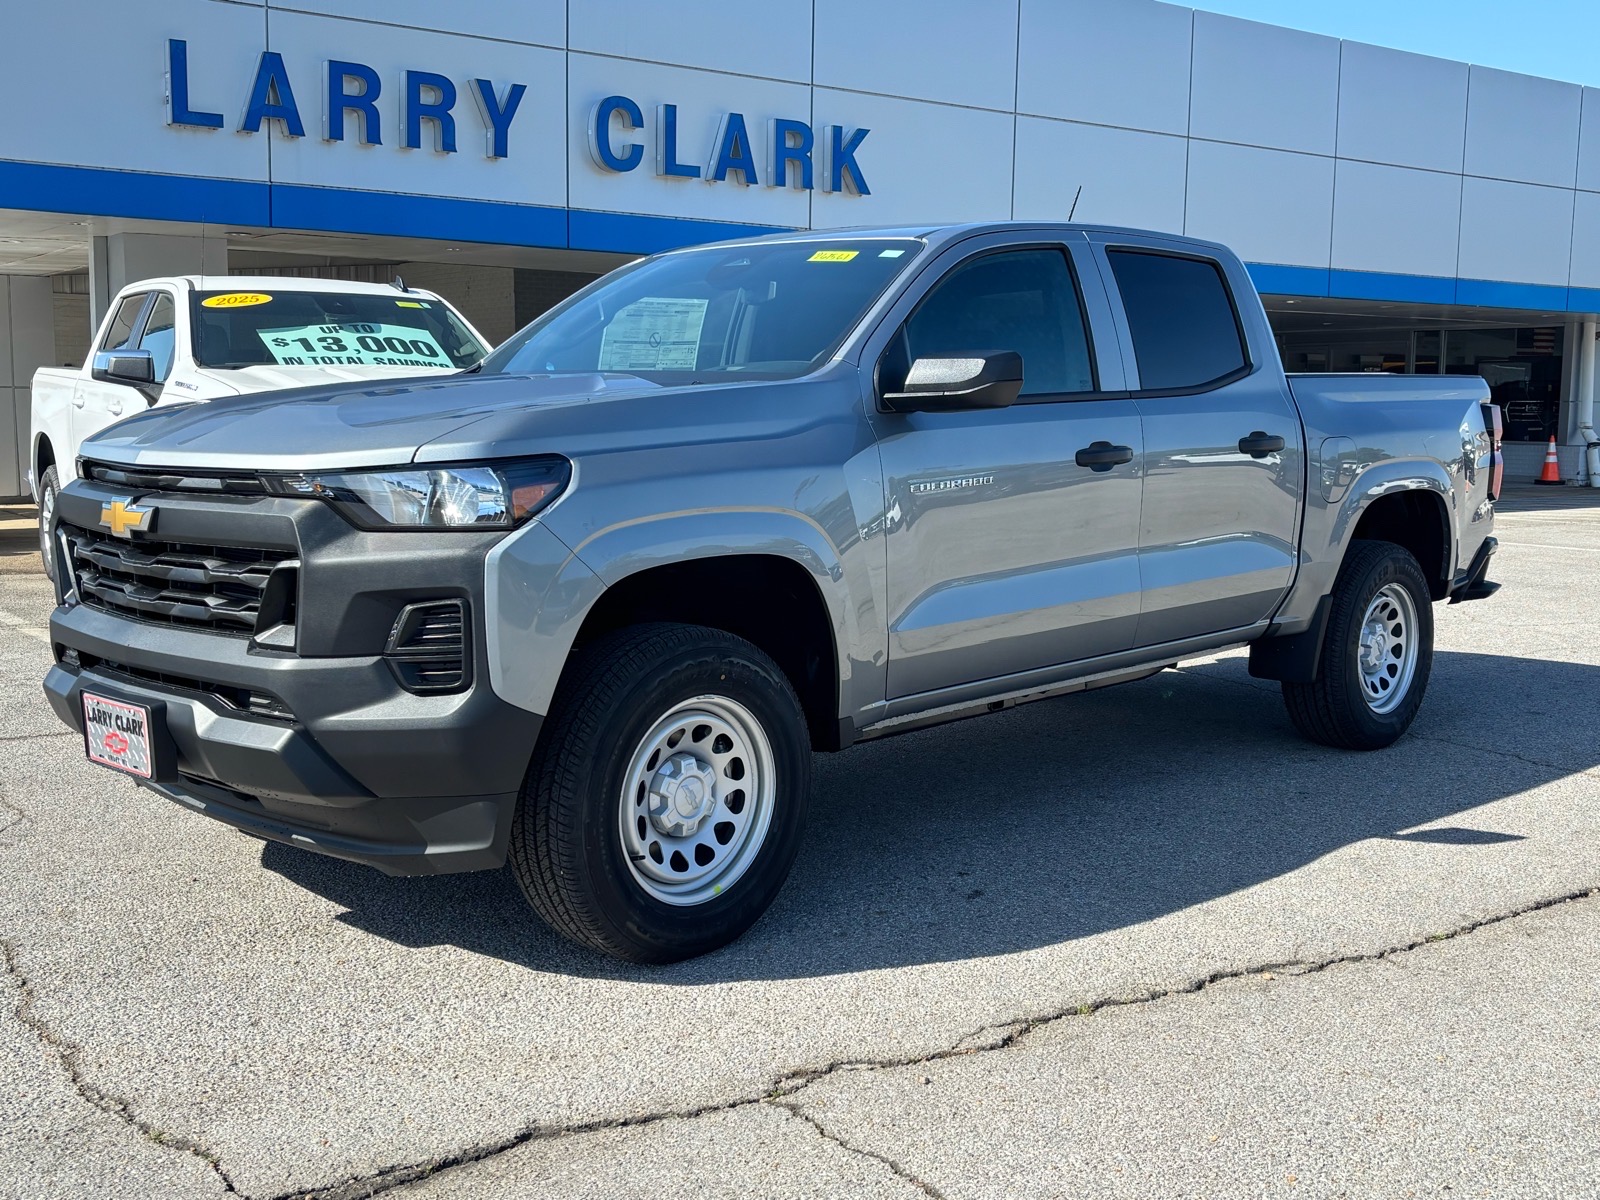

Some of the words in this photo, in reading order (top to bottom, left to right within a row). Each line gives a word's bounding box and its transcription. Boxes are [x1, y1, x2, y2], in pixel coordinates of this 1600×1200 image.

[166, 39, 527, 158] LARRY
[588, 96, 871, 195] CLARK
[215, 295, 260, 306] 2025
[319, 325, 344, 334] UP
[349, 324, 375, 334] TO
[271, 336, 439, 358] $13,000
[282, 356, 305, 365] IN
[910, 476, 994, 493] COLORADO
[87, 706, 112, 728] LARRY
[115, 714, 144, 737] CLARK
